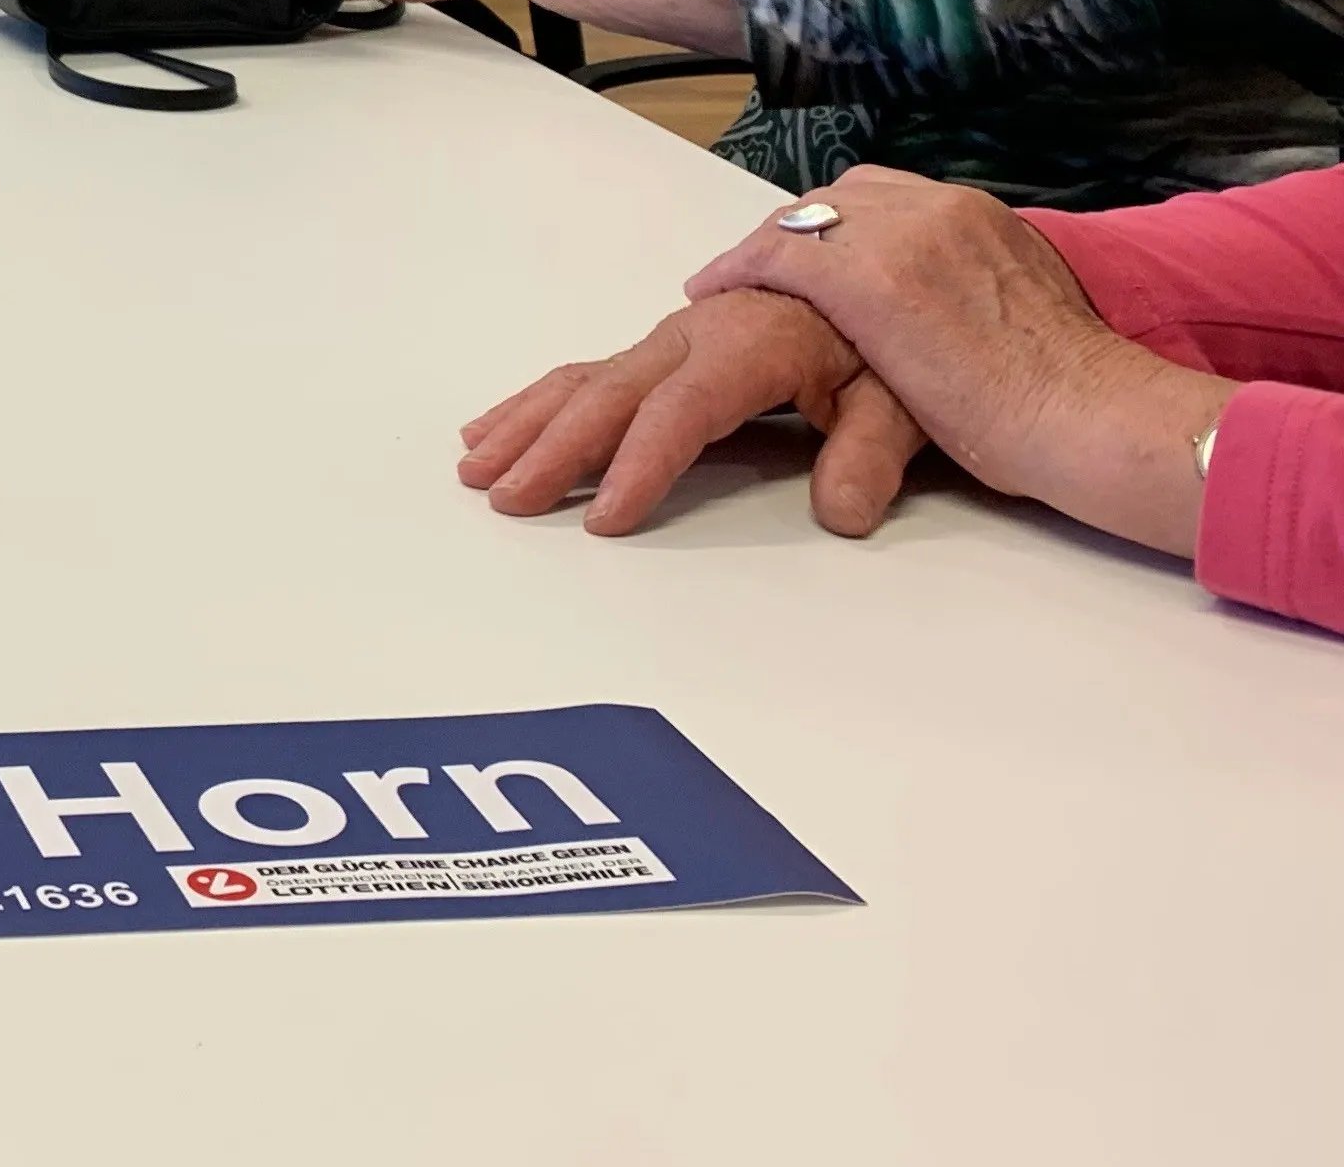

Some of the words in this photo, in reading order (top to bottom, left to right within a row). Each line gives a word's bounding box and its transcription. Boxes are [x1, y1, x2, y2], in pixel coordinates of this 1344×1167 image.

[256, 865, 310, 876] DEM
[314, 859, 394, 873] GLÜCK
[395, 859, 450, 870] EINE
[453, 851, 549, 869] CHANCE
[551, 843, 633, 860] GEBEN
[502, 860, 596, 877] PARTNER
[600, 857, 645, 868] DER
[270, 881, 453, 897] LOTTERIEN
[461, 865, 653, 891] SENIORENHILFE
